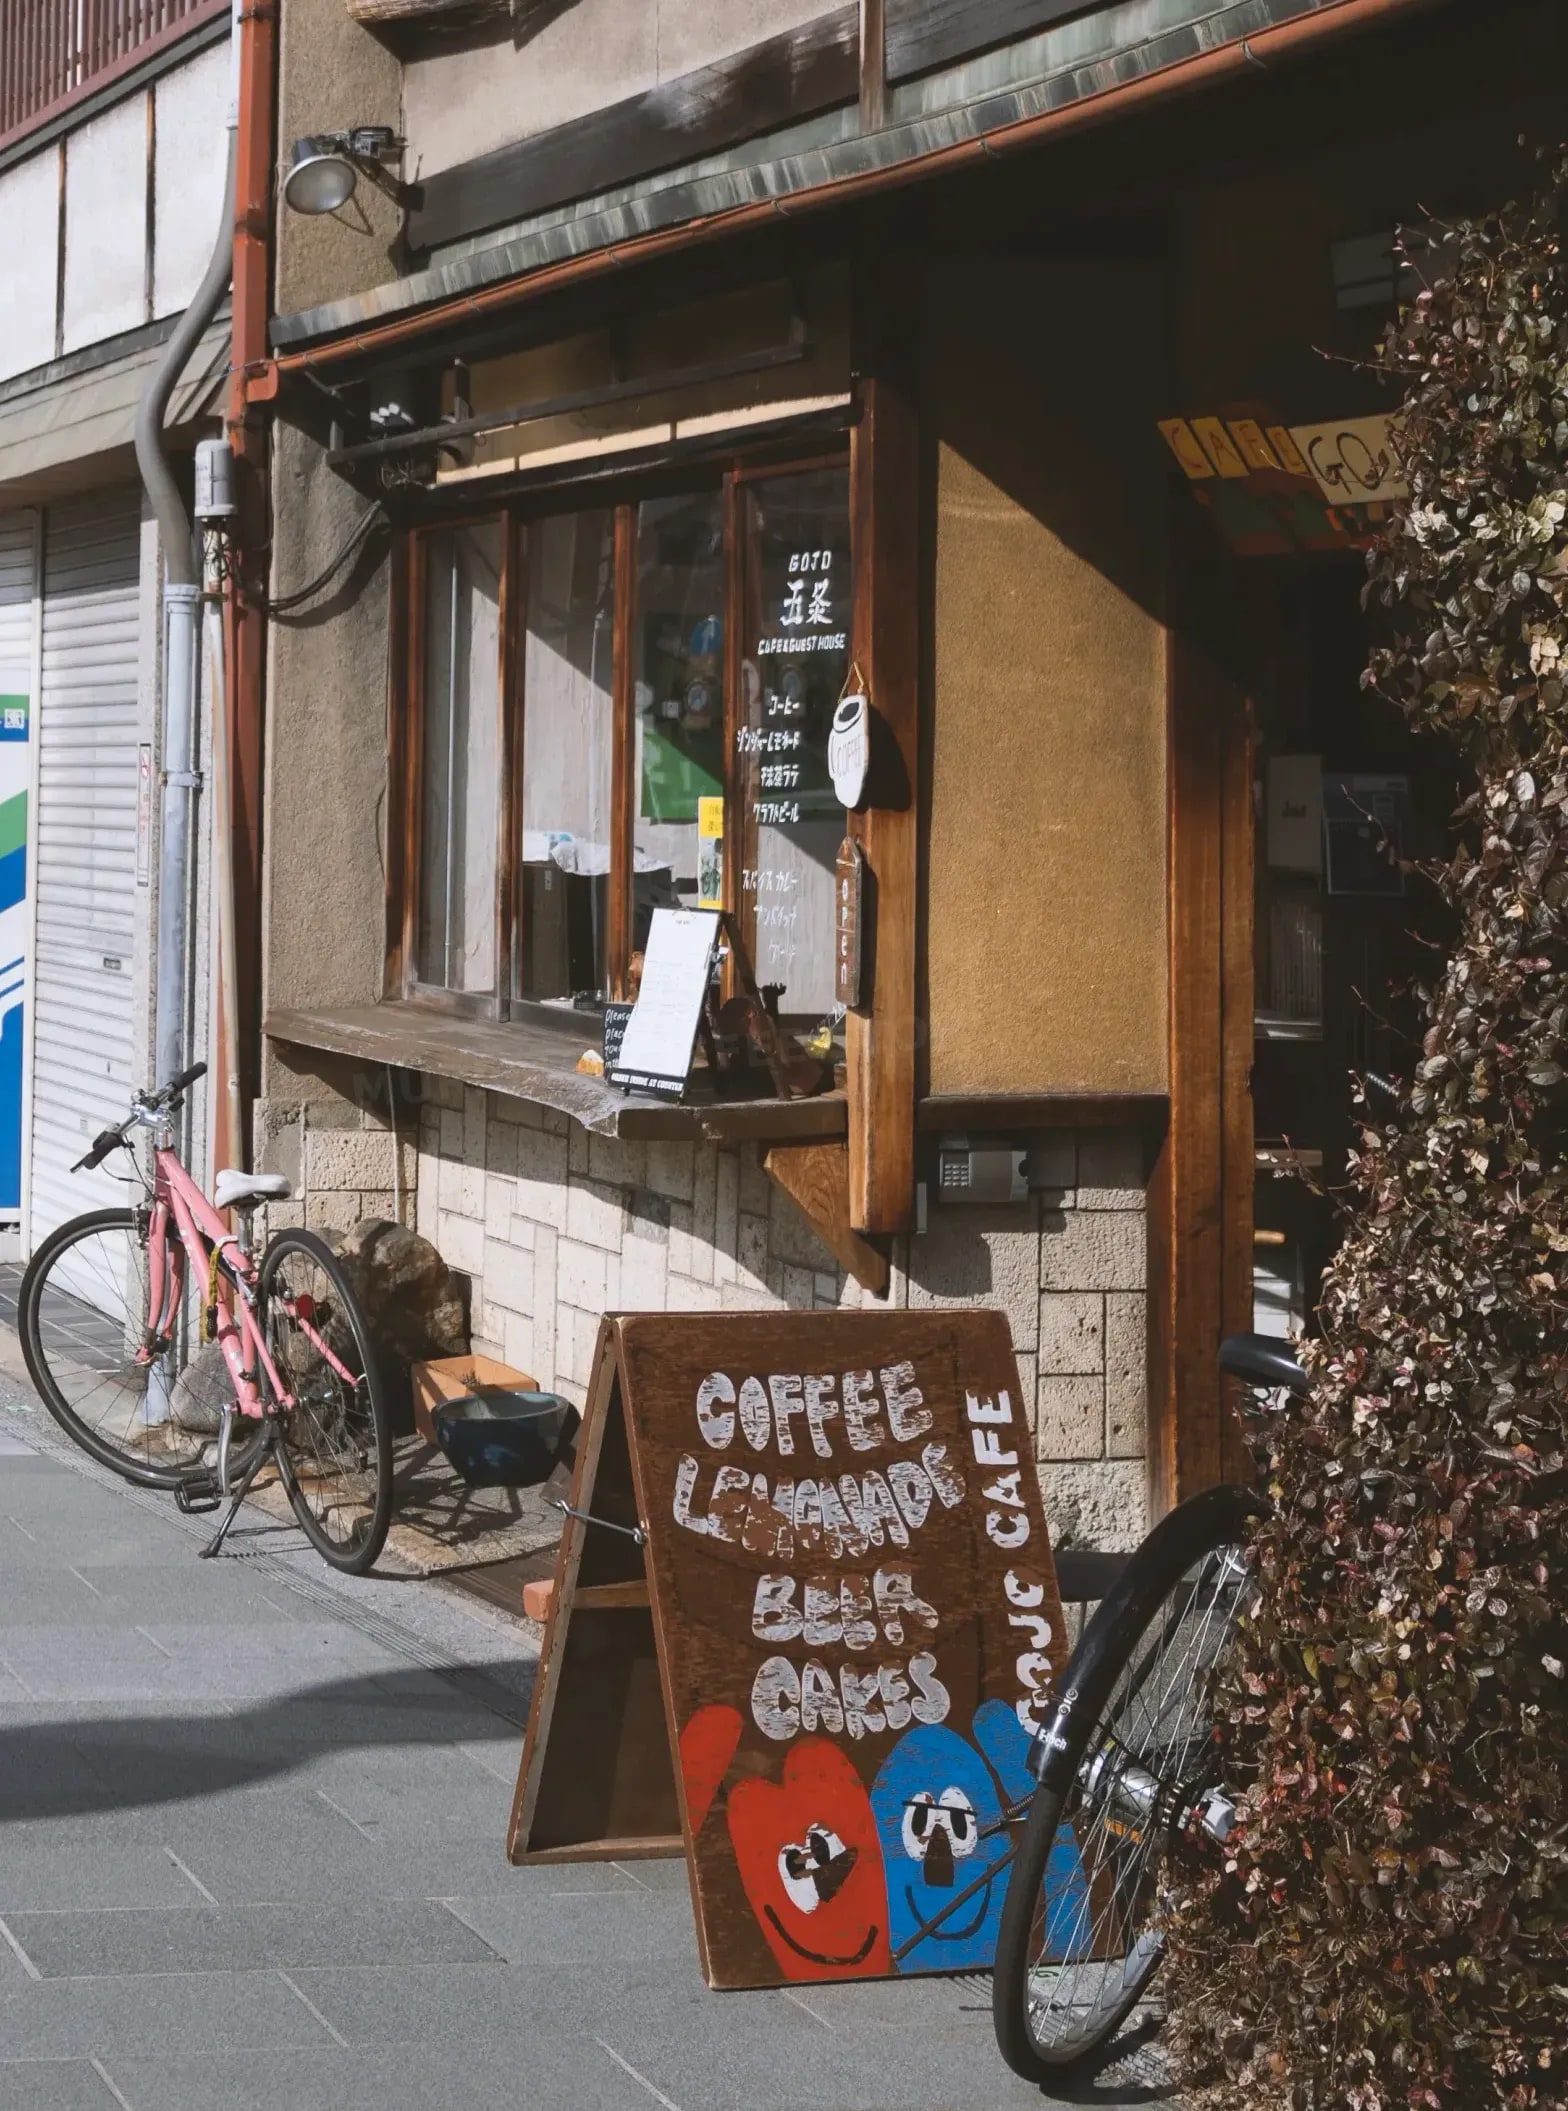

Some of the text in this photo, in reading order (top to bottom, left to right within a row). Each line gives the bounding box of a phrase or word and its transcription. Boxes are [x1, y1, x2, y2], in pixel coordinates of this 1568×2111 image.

[788, 551, 832, 572] GOJO
[817, 633, 846, 651] HOUSE
[768, 695, 800, 715] コーヒー
[761, 765, 799, 787] 抹茶ラテ
[753, 801, 799, 823] クラフトビール
[697, 1360, 933, 1457] COFFEE
[965, 1389, 1031, 1549] CAFE
[673, 1443, 966, 1559] LEMONADE
[751, 1562, 939, 1650] BEER
[751, 1651, 951, 1740] CAKES
